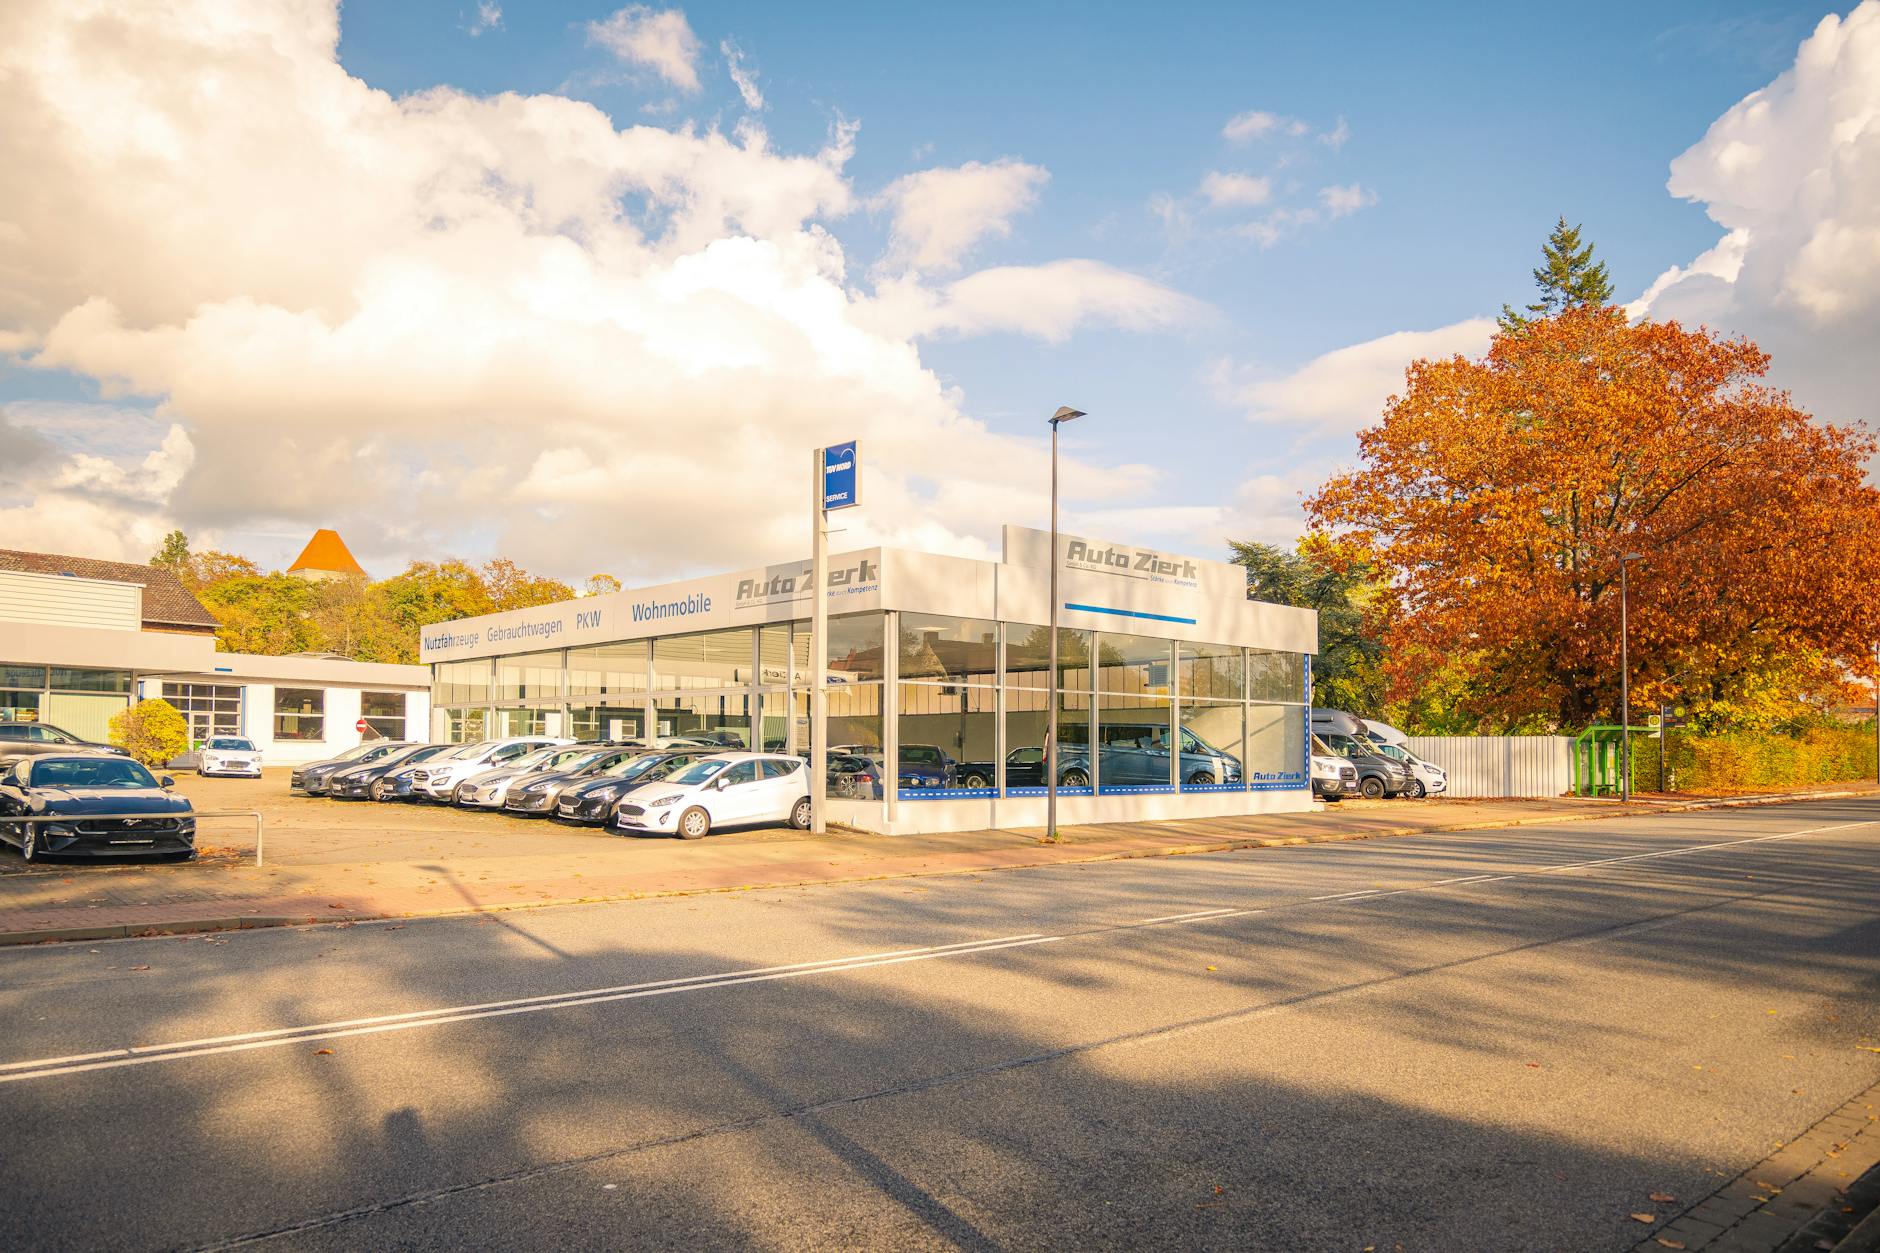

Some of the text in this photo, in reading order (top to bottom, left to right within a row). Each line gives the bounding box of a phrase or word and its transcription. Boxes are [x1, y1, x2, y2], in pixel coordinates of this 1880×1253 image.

[826, 492, 848, 502] SERVICE
[1067, 541, 1197, 579] Auto Zierk
[736, 560, 877, 600] Auto Zerk
[424, 593, 711, 651] Nutzfahrzeuge Gebrauchtwagen PKW Wohnmobile
[1253, 772, 1301, 780] Auto Zierk
